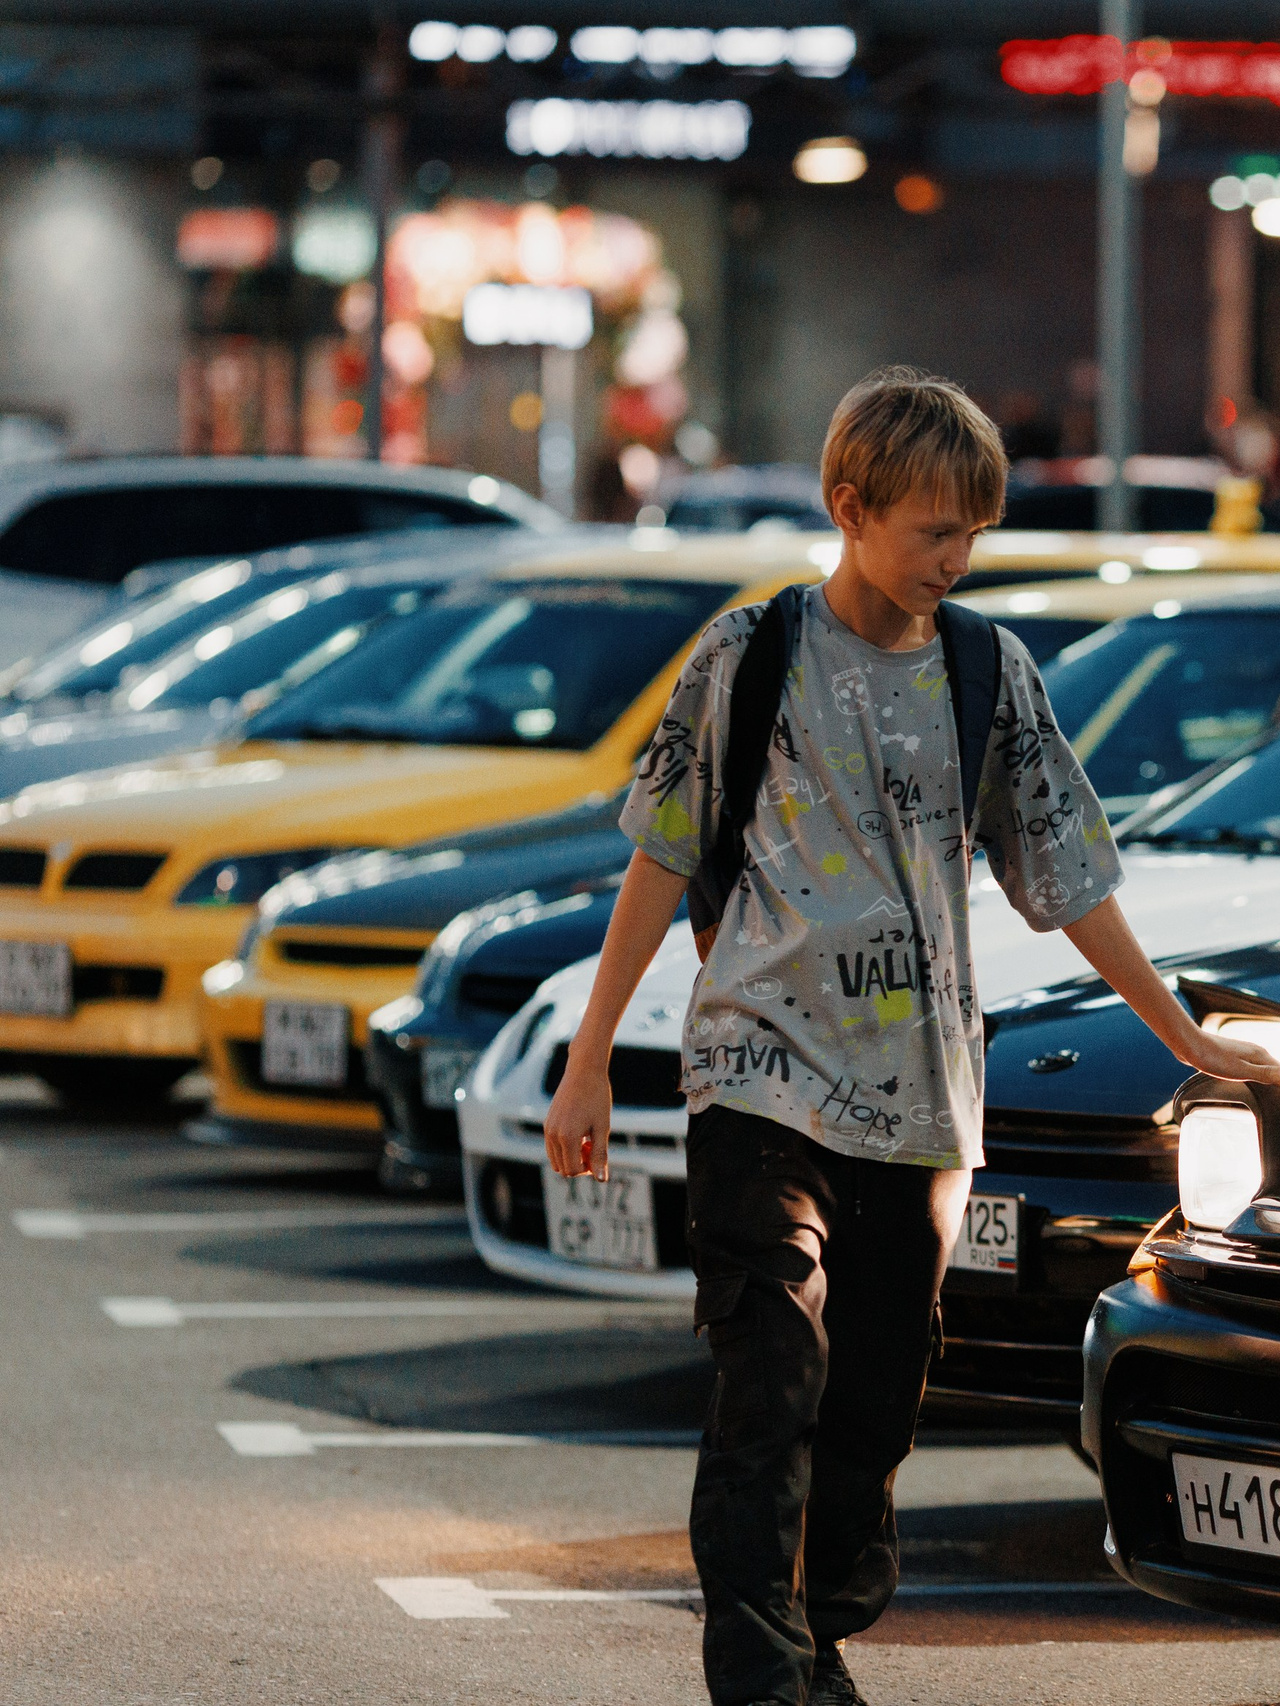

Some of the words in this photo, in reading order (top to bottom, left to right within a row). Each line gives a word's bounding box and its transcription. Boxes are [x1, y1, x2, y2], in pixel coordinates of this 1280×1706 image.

[1011, 791, 1073, 852] Hope
[817, 1076, 902, 1147] Hope
[965, 1201, 1008, 1247] 125
[970, 1248, 996, 1267] RUS
